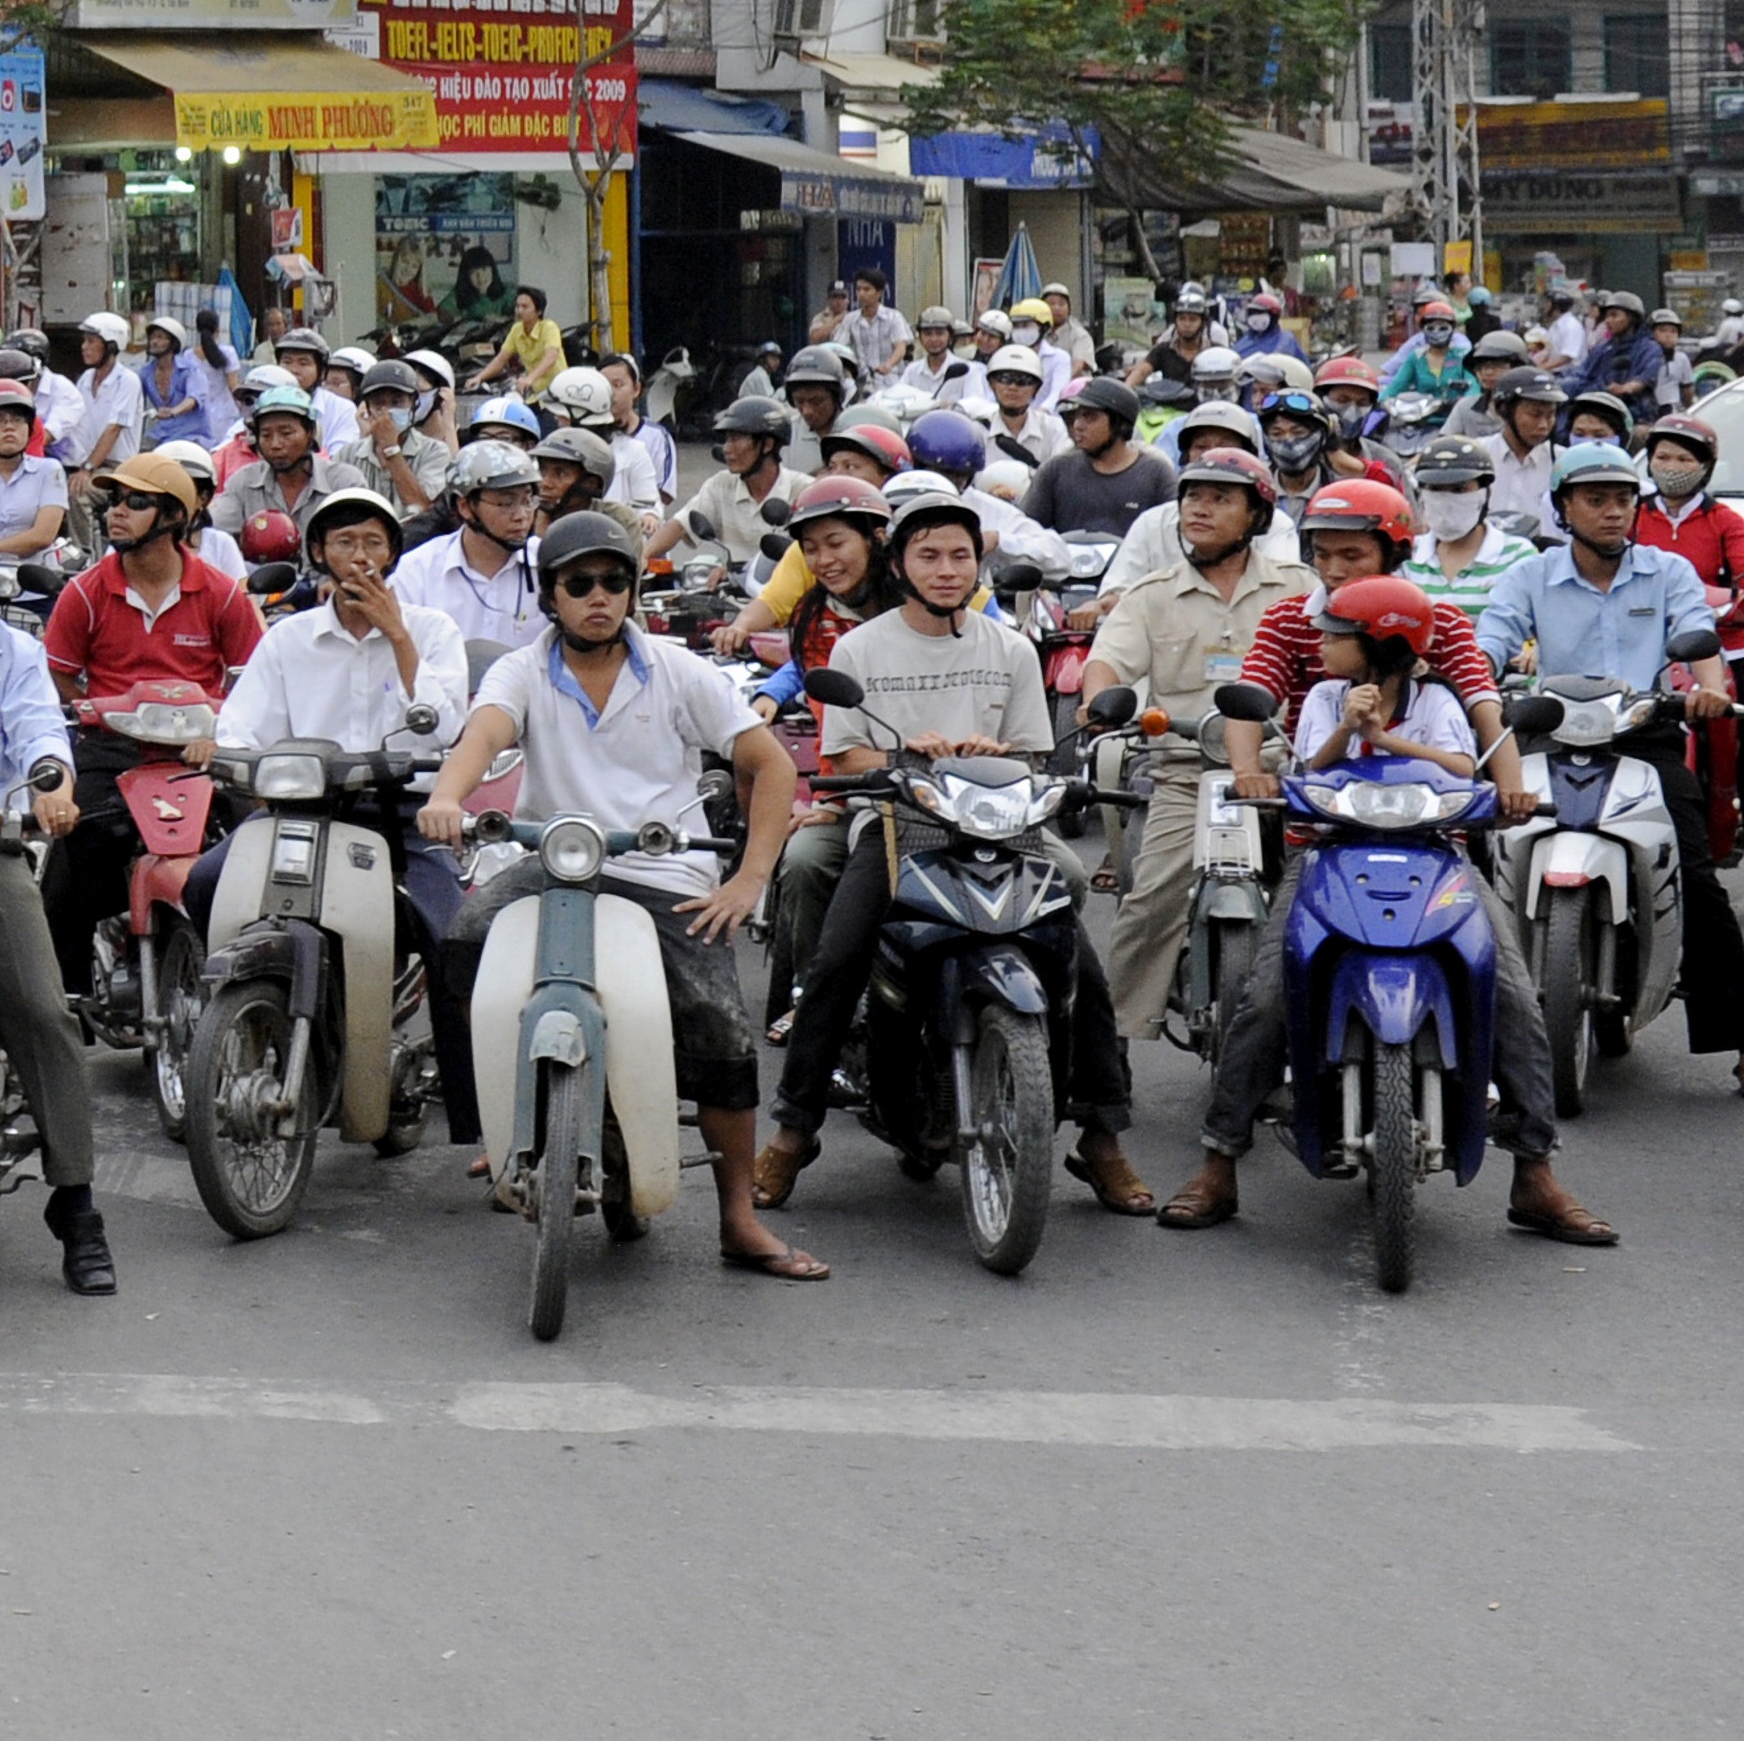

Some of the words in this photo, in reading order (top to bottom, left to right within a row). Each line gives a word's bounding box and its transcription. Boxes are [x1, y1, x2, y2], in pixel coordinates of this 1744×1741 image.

[441, 75, 471, 105] HIỆU
[475, 74, 500, 99] ĐÀO
[505, 78, 529, 103] TẠO
[532, 70, 563, 100] XUẤT
[595, 79, 626, 101] 2009
[268, 105, 317, 139] MINH
[321, 98, 393, 139] PHƯƠNG
[464, 111, 486, 135] PHÍ
[490, 108, 521, 135] GIẢM
[525, 112, 550, 143] ĐẶC
[384, 218, 429, 230] TOEIC
